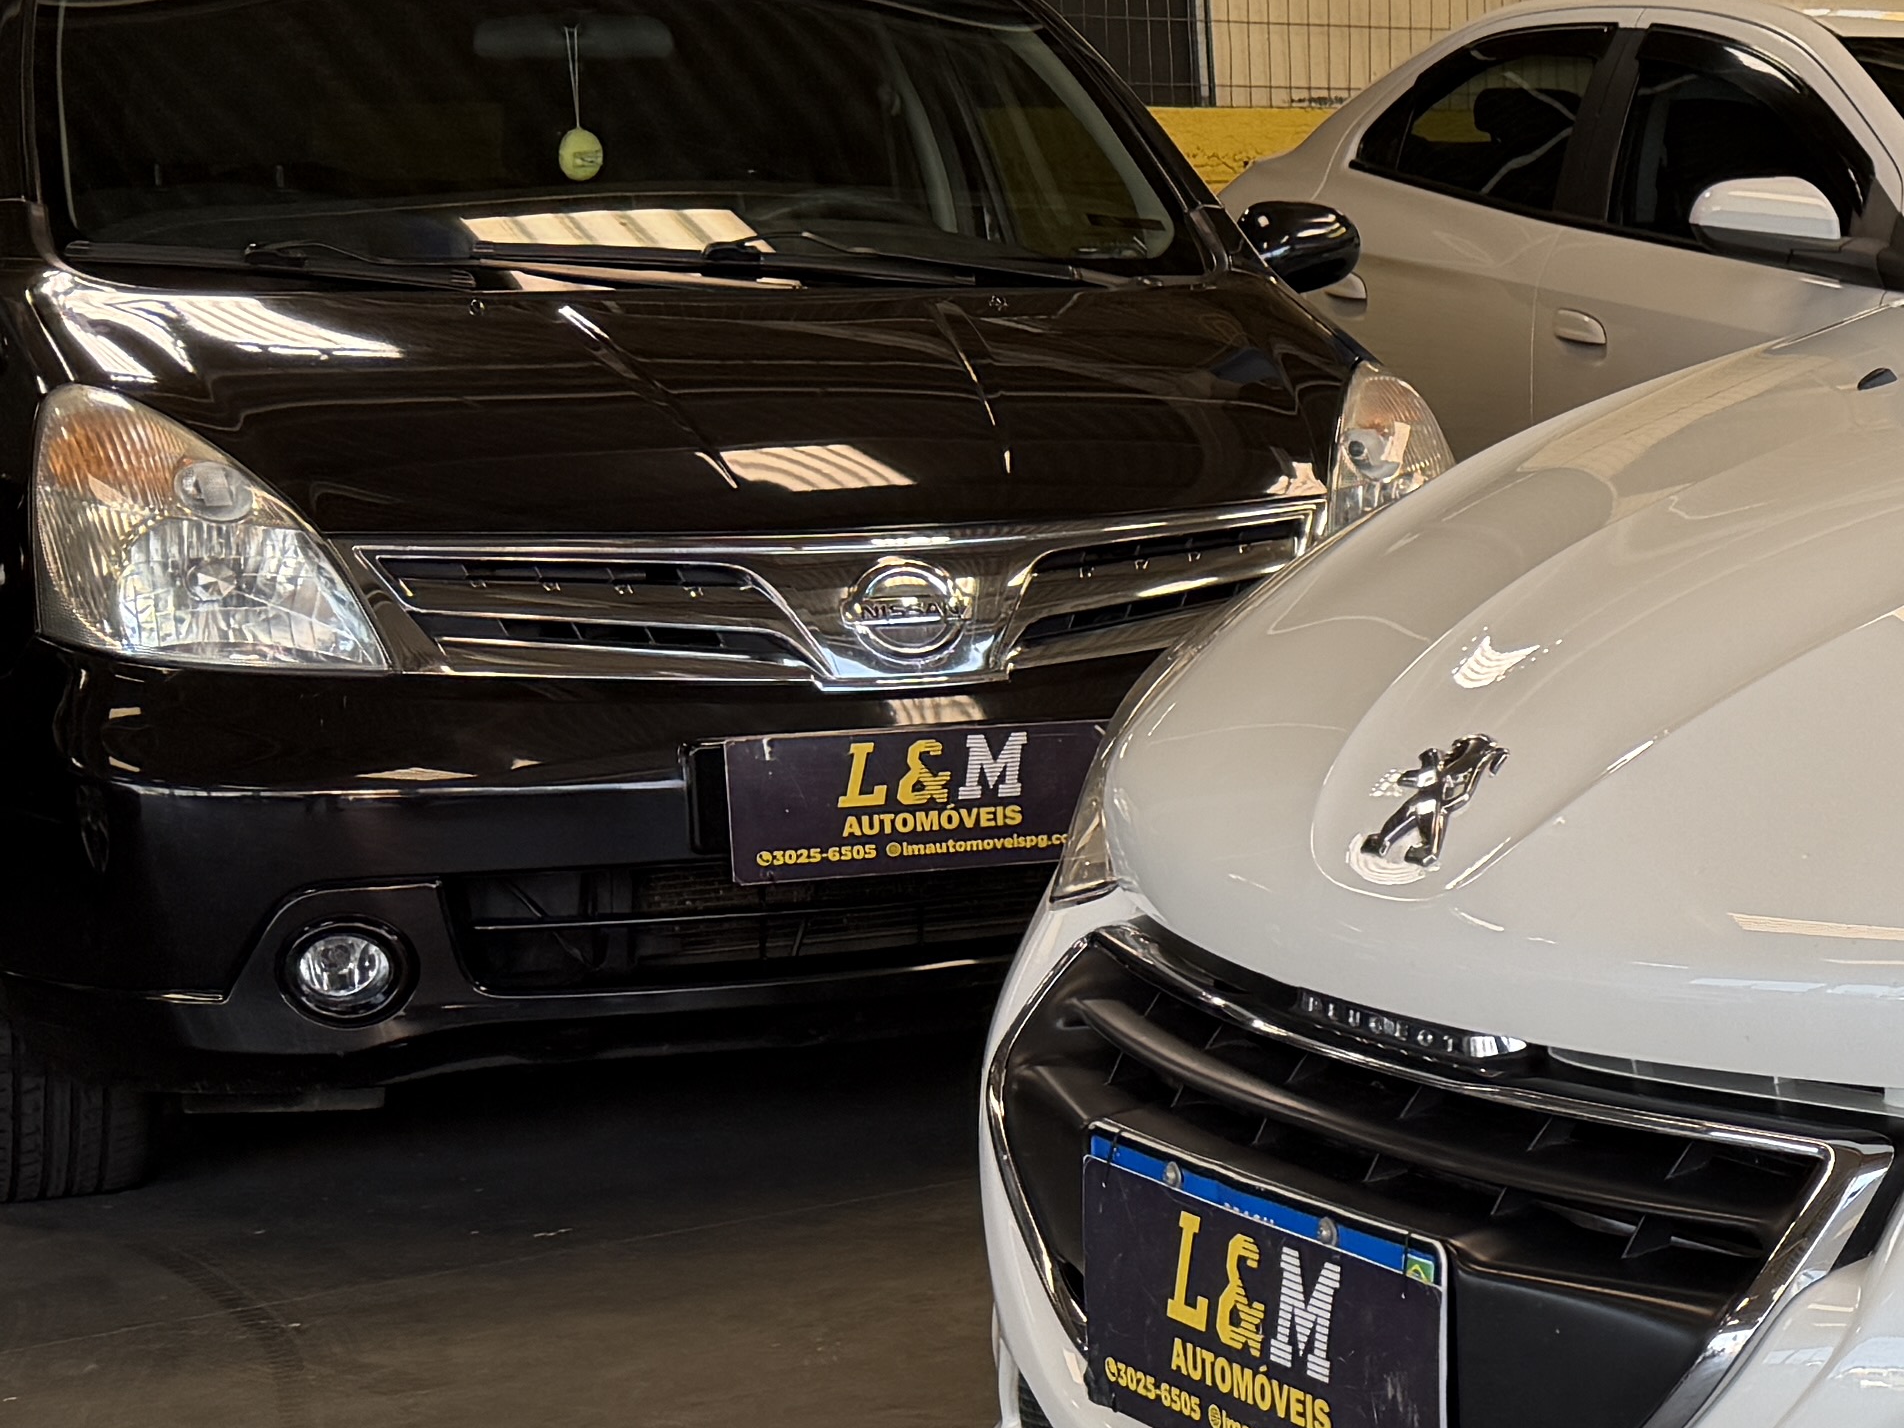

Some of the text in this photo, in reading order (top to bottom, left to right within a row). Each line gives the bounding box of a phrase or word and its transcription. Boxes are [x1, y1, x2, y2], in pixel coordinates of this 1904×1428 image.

[859, 600, 966, 620] NISSAN
[838, 731, 1028, 808] L&M
[842, 803, 1023, 837] AUTOMÓVEIS
[773, 843, 877, 866] 3025-6505
[1166, 1210, 1341, 1384] L&M
[1117, 1361, 1202, 1421] 3025-6505
